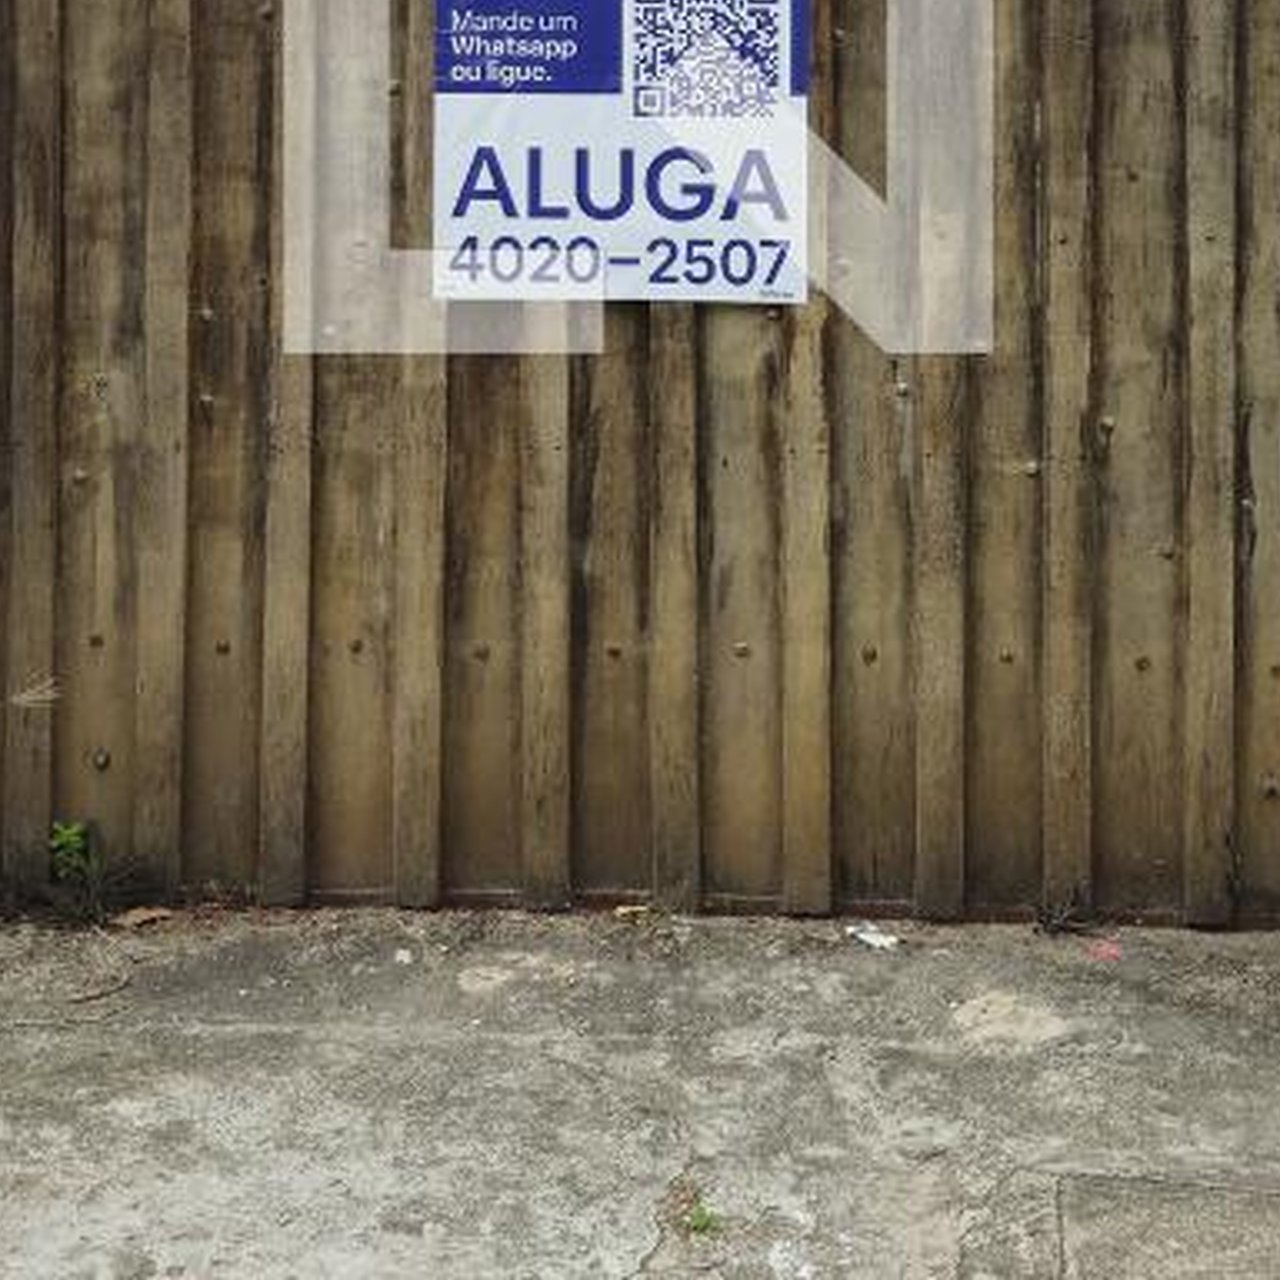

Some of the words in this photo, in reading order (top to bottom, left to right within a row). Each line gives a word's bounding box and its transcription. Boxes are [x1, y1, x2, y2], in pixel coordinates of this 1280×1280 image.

[451, 10, 540, 32] Mande
[543, 13, 578, 32] um
[450, 36, 578, 61] Whatsapp
[451, 64, 482, 81] ou
[485, 60, 552, 87] ligue.
[451, 146, 789, 222] ALUGA
[449, 235, 791, 286] 4020-2507
